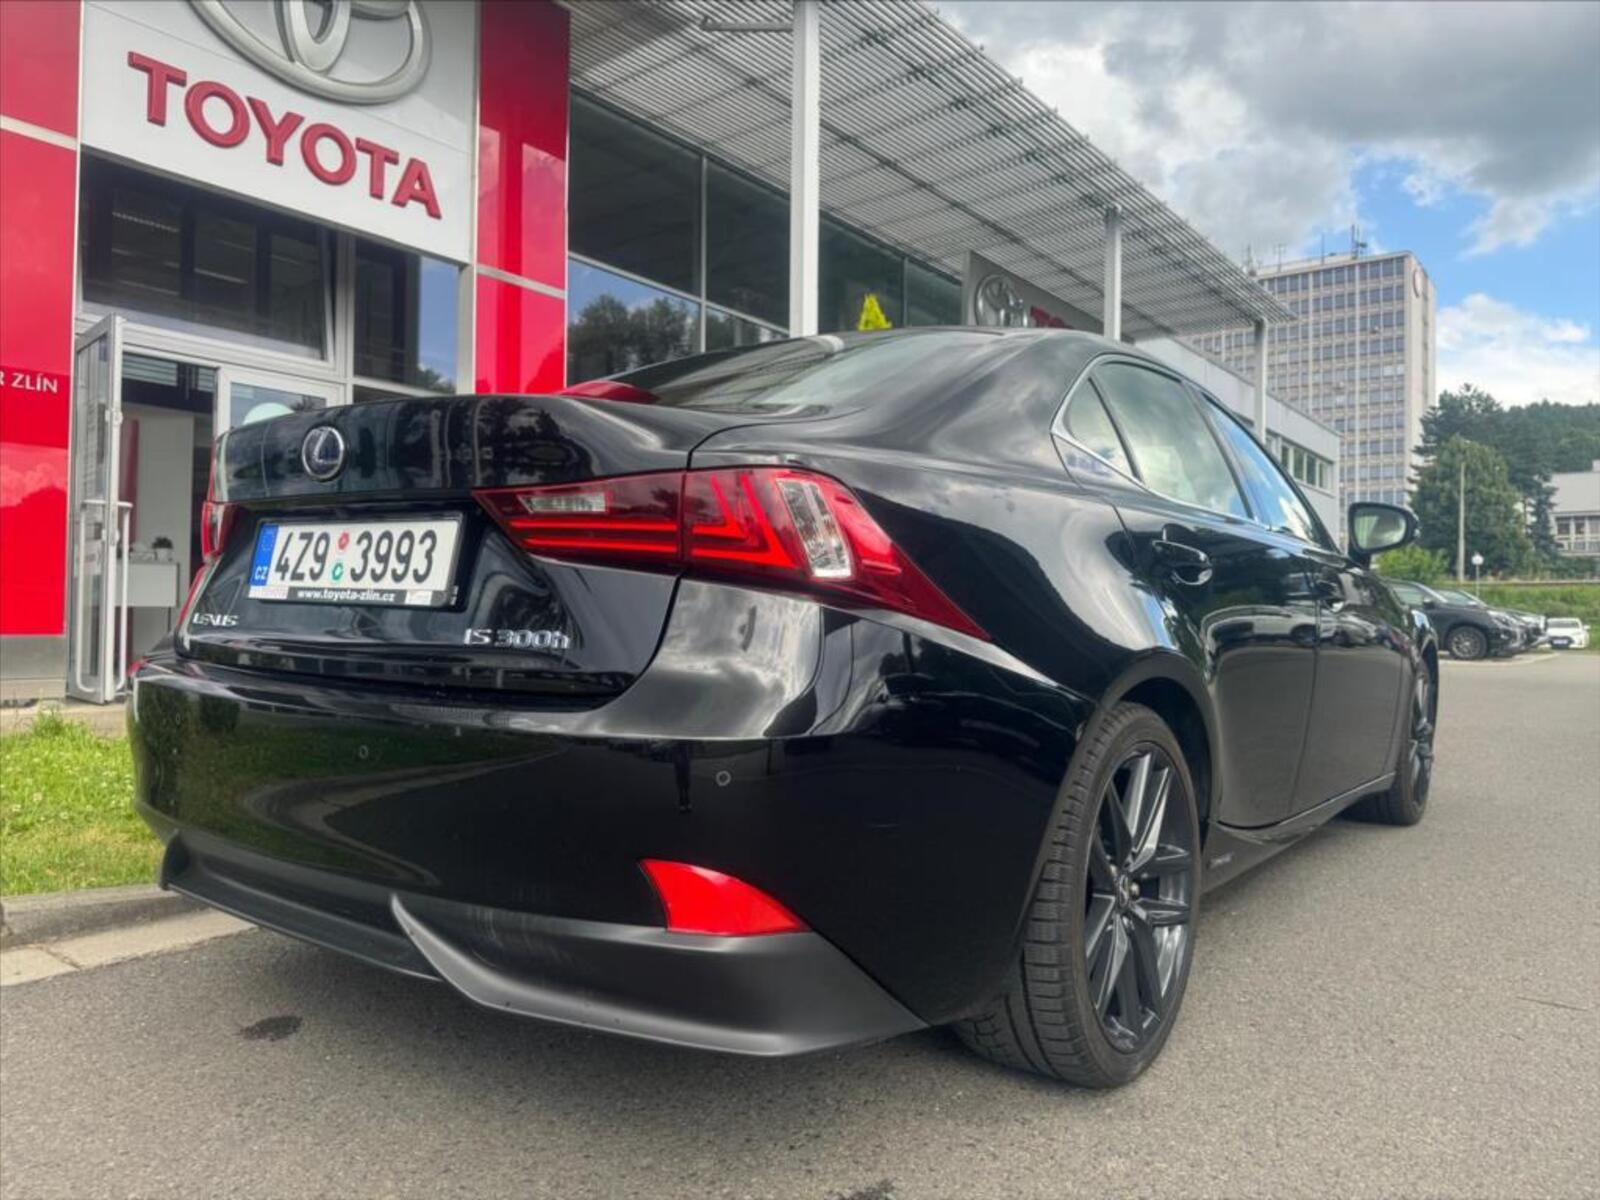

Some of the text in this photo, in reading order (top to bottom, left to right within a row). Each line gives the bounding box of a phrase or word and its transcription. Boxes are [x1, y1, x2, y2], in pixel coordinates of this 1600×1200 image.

[127, 51, 442, 220] TOYOTA
[11, 372, 58, 394] ZLÍN
[275, 529, 437, 583] 4Z9 3993
[254, 567, 268, 580] CZ
[297, 587, 396, 603] www.toyota-zlin.cz
[464, 628, 569, 649] IS 300h
